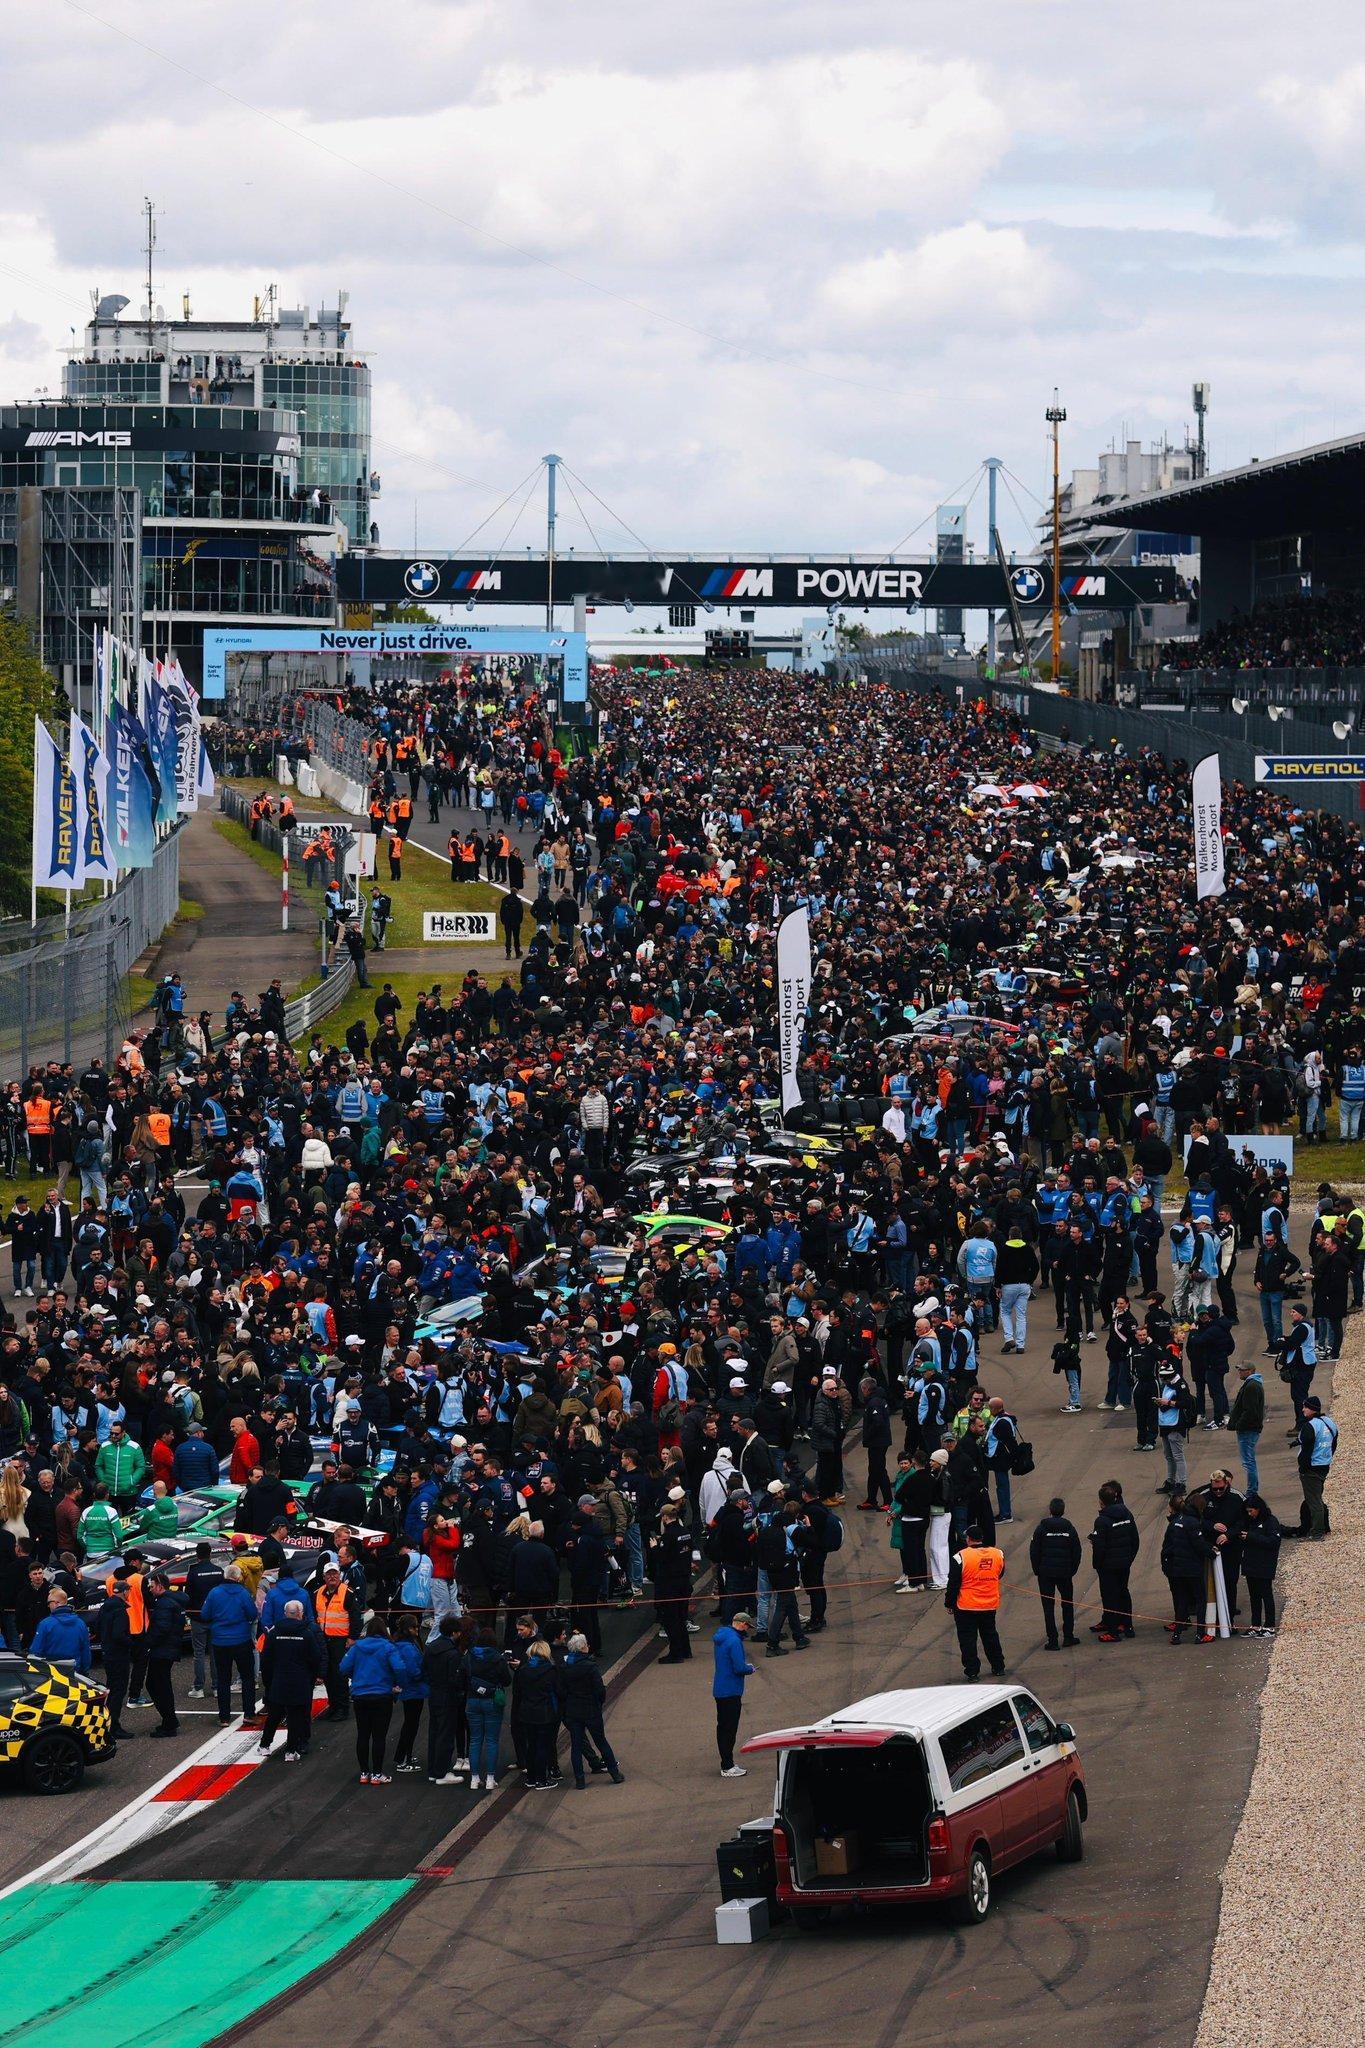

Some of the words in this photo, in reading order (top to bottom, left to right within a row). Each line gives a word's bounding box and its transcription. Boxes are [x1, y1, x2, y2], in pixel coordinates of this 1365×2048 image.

[51, 431, 131, 446] AMG
[797, 569, 923, 598] POWER
[320, 632, 377, 649] Never
[379, 632, 416, 652] just
[418, 632, 472, 650] drive.
[1273, 763, 1364, 775] RAVENOL
[1198, 804, 1208, 873] Walkenhorst
[432, 916, 466, 932] H&R
[782, 978, 792, 1075] Walkenhorst
[367, 1535, 385, 1545] ABT
